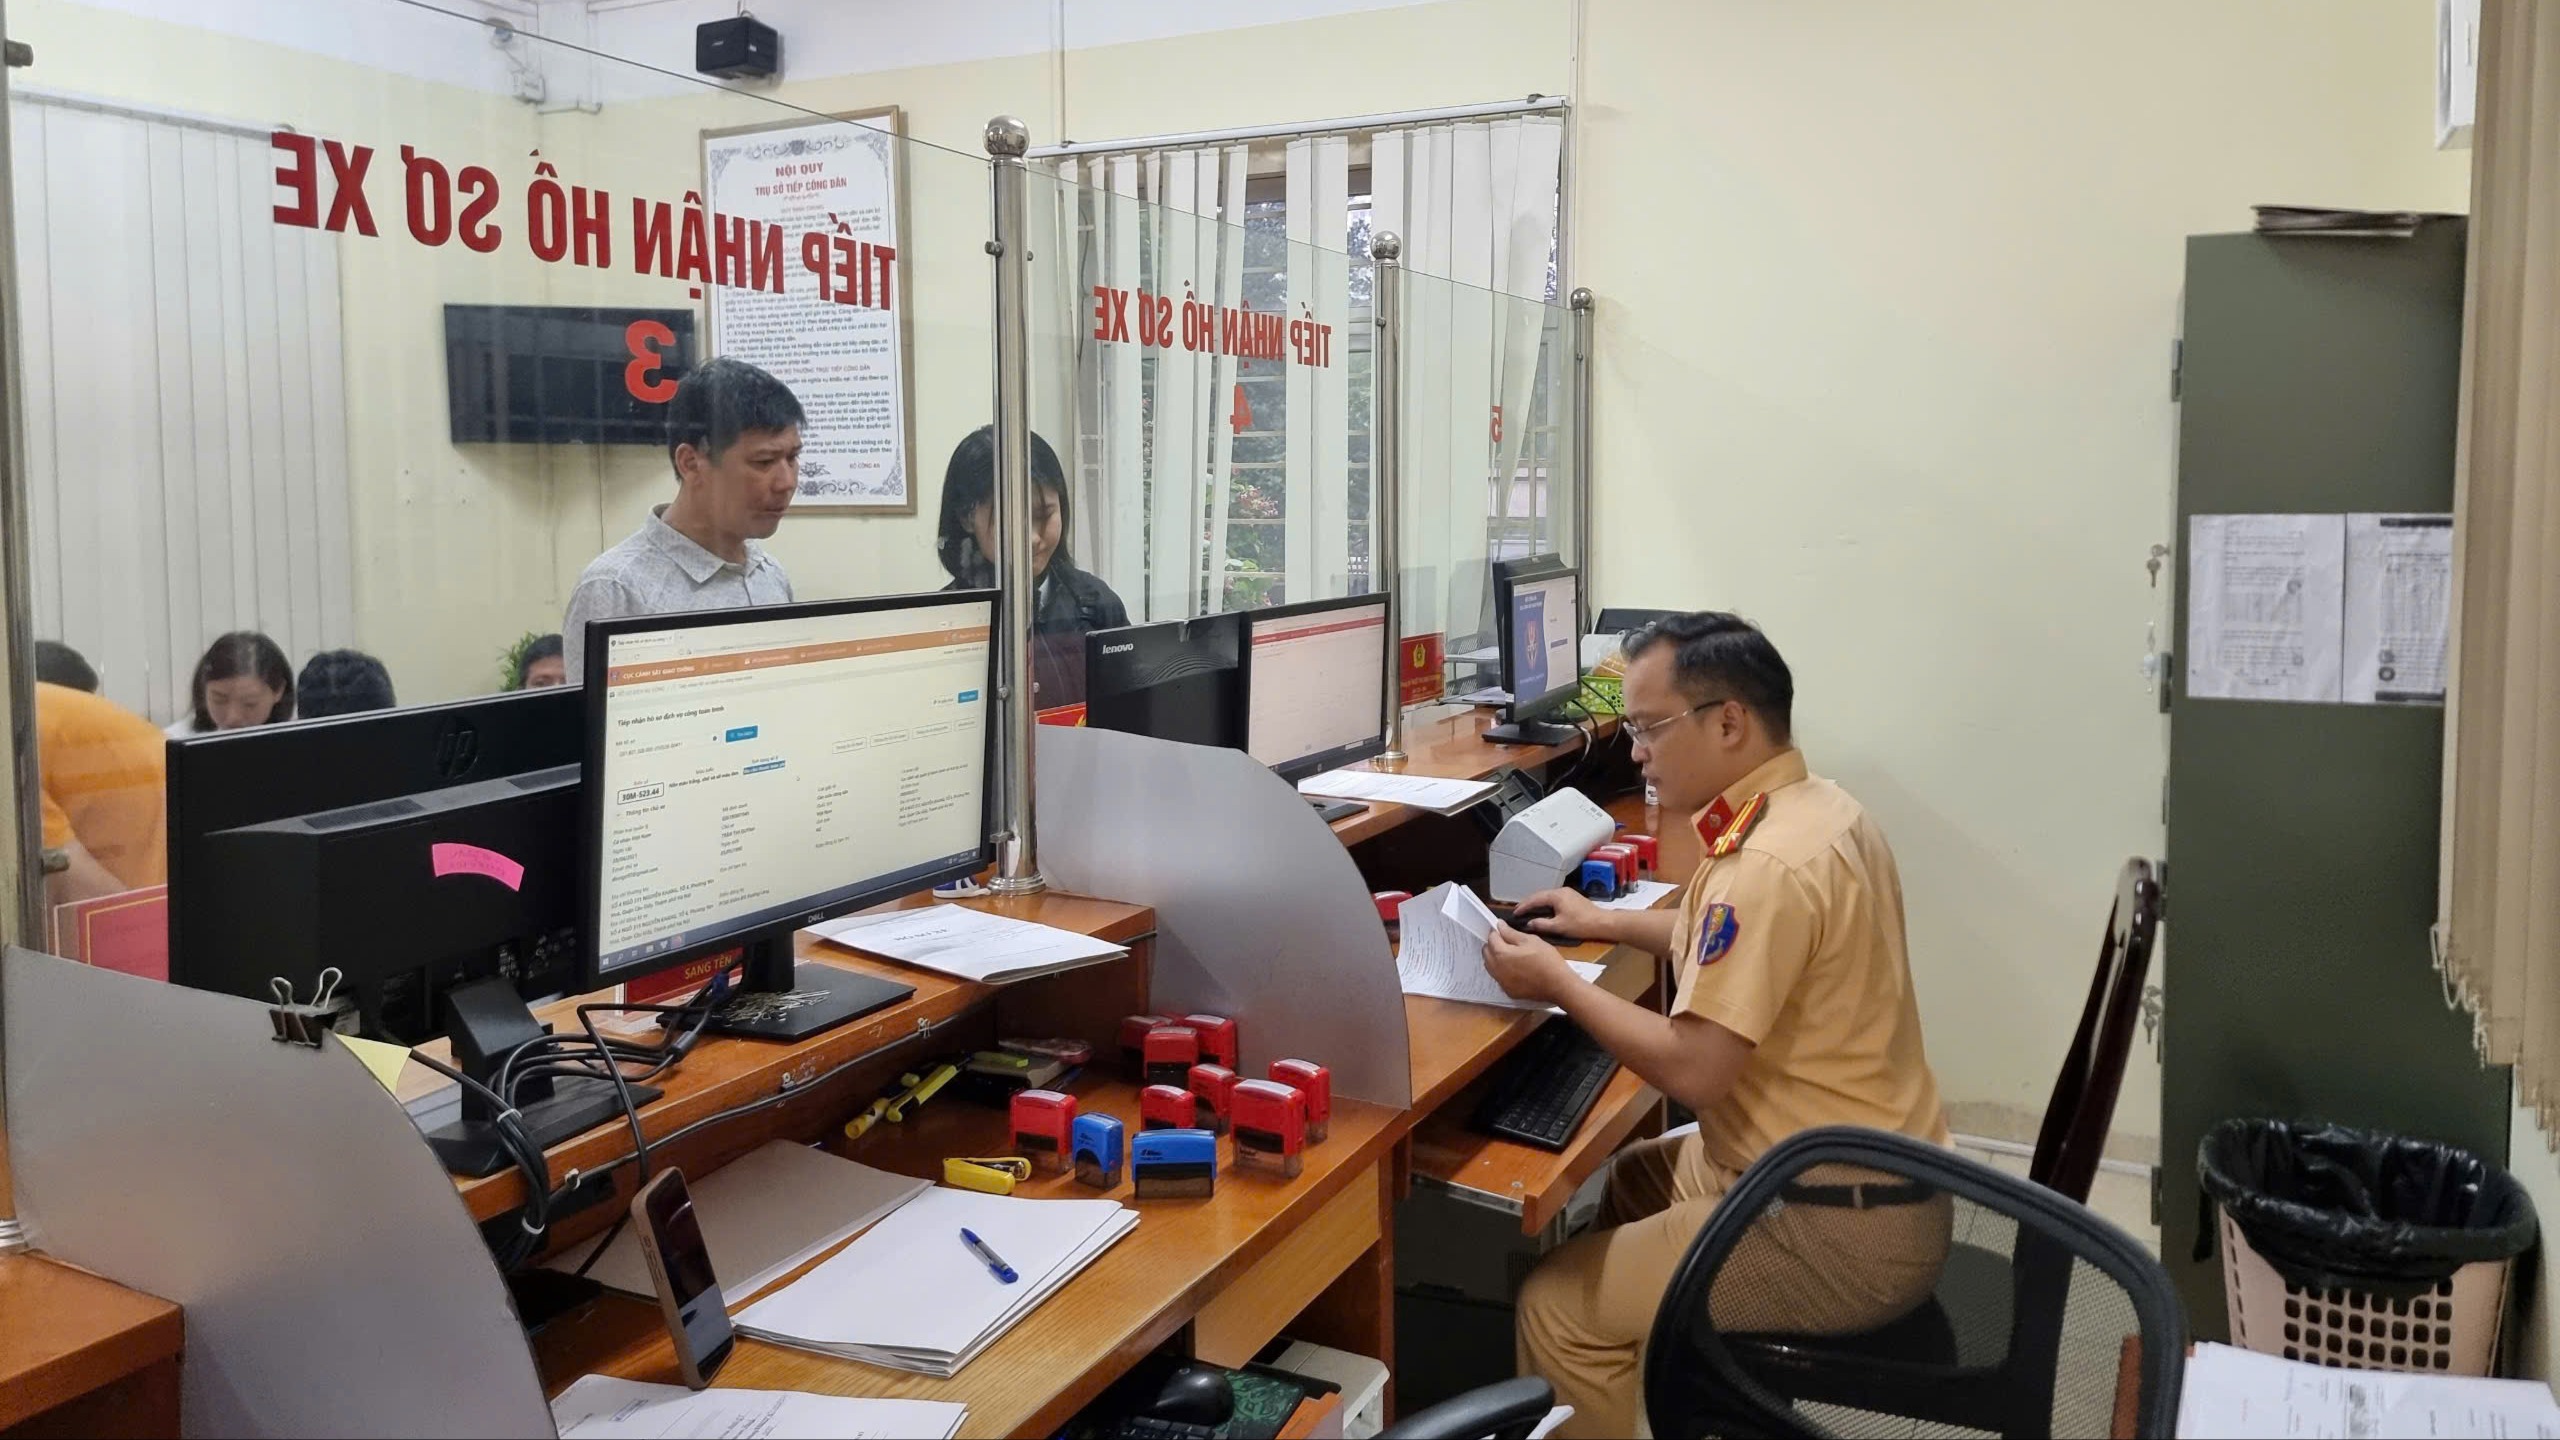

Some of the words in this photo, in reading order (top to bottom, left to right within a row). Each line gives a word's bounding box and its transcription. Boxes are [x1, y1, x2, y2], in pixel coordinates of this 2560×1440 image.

[775, 164, 796, 177] NỘI
[800, 162, 824, 174] QUY
[755, 186, 771, 197] TRỤ
[773, 181, 784, 195] SỞ
[786, 180, 803, 193] TIẾP
[805, 179, 828, 191] CÔNG
[830, 177, 847, 189] DÂN
[1102, 642, 1134, 655] lenovo
[808, 911, 825, 924] DELL
[684, 960, 712, 980] SANG
[714, 954, 732, 970] TÊN
